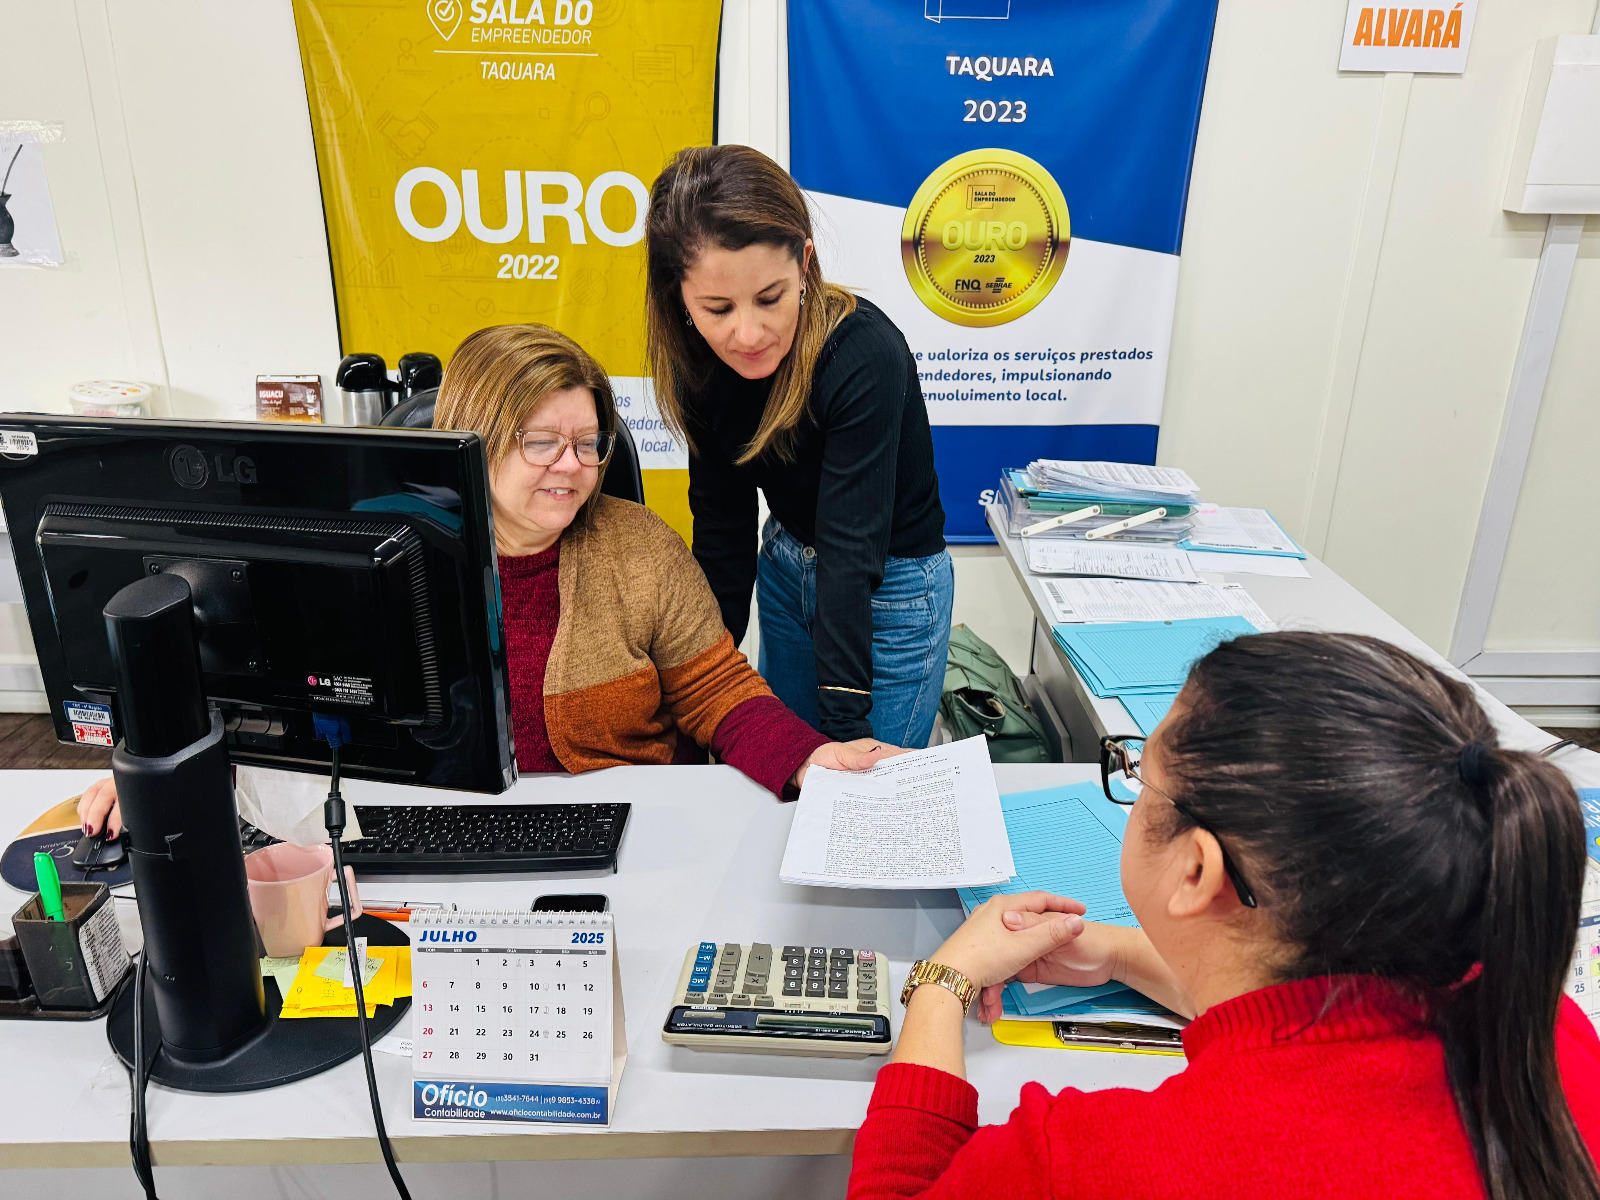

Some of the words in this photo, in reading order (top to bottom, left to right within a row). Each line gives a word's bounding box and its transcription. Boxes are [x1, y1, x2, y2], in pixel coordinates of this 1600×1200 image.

[468, 0, 541, 25] SALA
[554, 0, 594, 25] DO
[1352, 2, 1464, 49] ALVARÁ
[470, 27, 593, 46] EMPREENDEDOR
[480, 61, 556, 81] TAQUARA
[945, 55, 1055, 82] TAQUARA
[962, 99, 1028, 123] 2023
[394, 166, 650, 248] OURO
[941, 220, 1028, 251] OURO
[973, 254, 996, 264] 2023
[496, 253, 560, 281] 2022
[954, 279, 982, 293] FNQ
[985, 281, 1013, 290] SEBRAE
[927, 347, 990, 361] valoriza
[993, 351, 1010, 361] os
[1014, 347, 1077, 365] serviços
[1079, 347, 1154, 364] prestados
[917, 368, 997, 384] endedores,
[1001, 367, 1113, 385] impulsionando
[922, 388, 1022, 402] envolvimento
[1025, 388, 1068, 402] local.
[640, 438, 675, 453] local.
[213, 454, 258, 484] LG
[318, 677, 332, 687] LG
[419, 930, 478, 943] JULHO
[571, 932, 605, 944] 2025
[475, 958, 480, 966] 1
[502, 958, 508, 967] 2
[529, 959, 535, 967] 3
[555, 959, 562, 968] 4
[582, 960, 588, 968] 5
[1574, 966, 1584, 977] 18
[422, 980, 428, 989] 6
[449, 981, 455, 989] 7
[475, 981, 481, 990] 8
[502, 982, 508, 990] 9
[529, 982, 540, 991] 10
[556, 983, 566, 991] 11
[583, 983, 594, 992] 12
[1574, 983, 1586, 994] 25
[423, 1003, 433, 1012] 13
[449, 1004, 460, 1012] 14
[476, 1004, 486, 1013] 15
[502, 1005, 513, 1014] 16
[529, 1006, 540, 1014] 17
[556, 1006, 566, 1015] 18
[582, 1007, 593, 1016] 19
[422, 1027, 434, 1036] 20
[449, 1027, 459, 1036] 21
[475, 1028, 486, 1036] 22
[502, 1029, 513, 1037] 23
[529, 1029, 540, 1038] 24
[556, 1030, 567, 1039] 25
[582, 1031, 593, 1040] 26
[422, 1051, 433, 1059] 27
[449, 1051, 460, 1059] 28
[476, 1052, 487, 1060] 29
[502, 1052, 513, 1061] 30
[529, 1053, 539, 1062] 31
[421, 1083, 488, 1107] Ofício
[423, 1107, 486, 1119] Contabilidade
